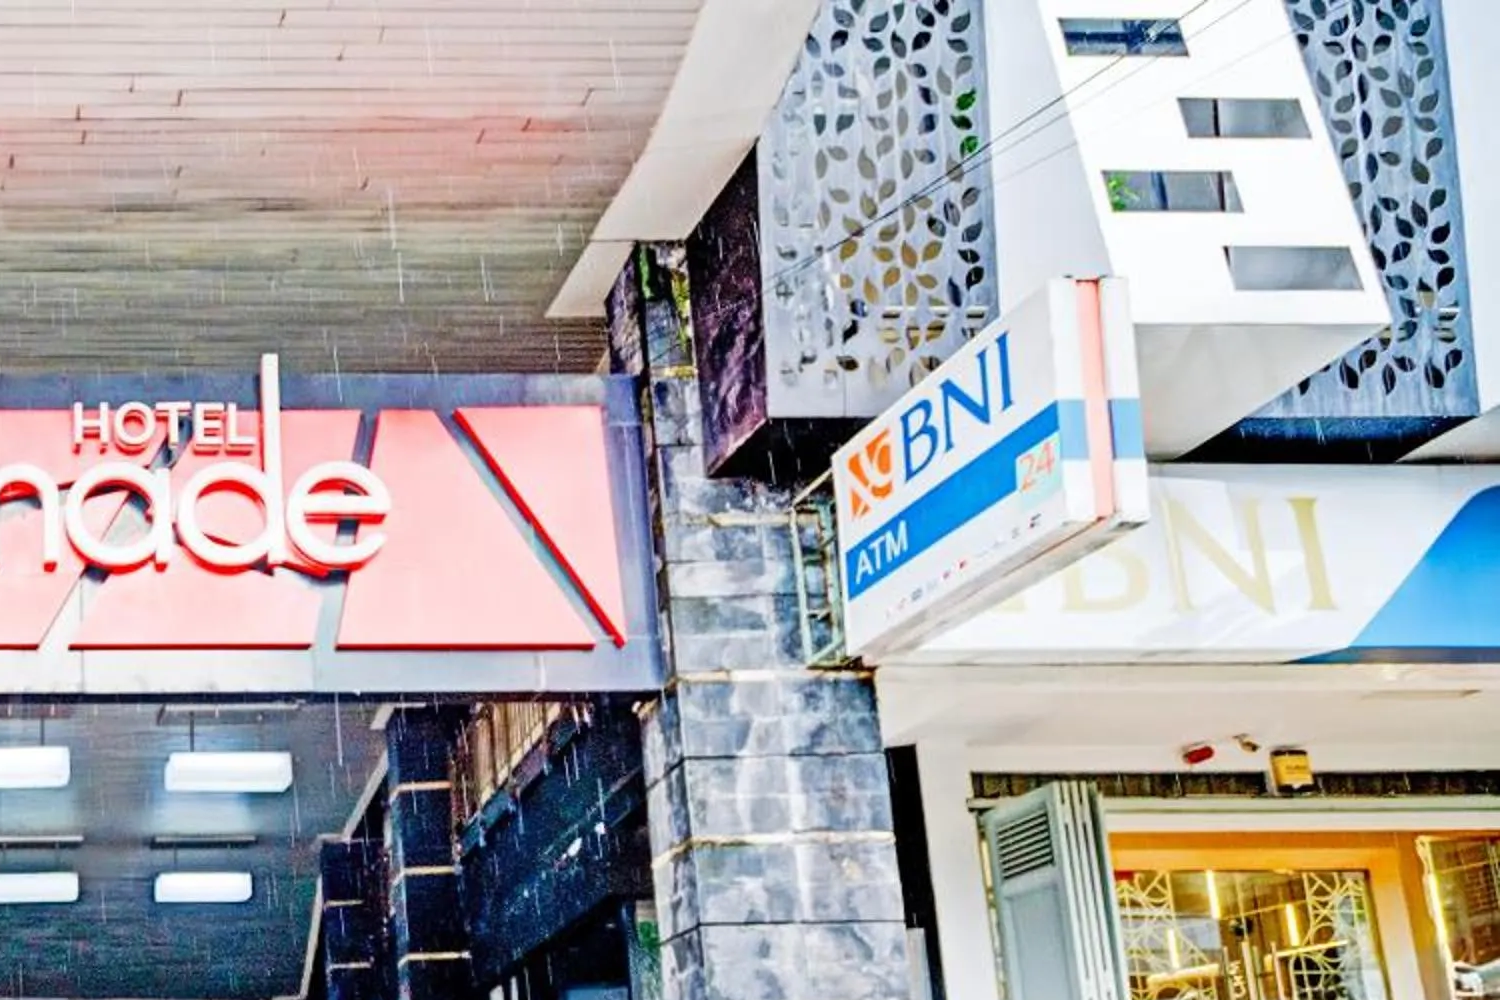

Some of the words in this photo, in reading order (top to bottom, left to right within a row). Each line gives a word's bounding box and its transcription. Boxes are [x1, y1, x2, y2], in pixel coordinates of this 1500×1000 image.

[72, 401, 256, 455] HOTEL
[900, 331, 1014, 483] BNI
[1019, 441, 1057, 494] 24
[853, 519, 910, 586] ATM
